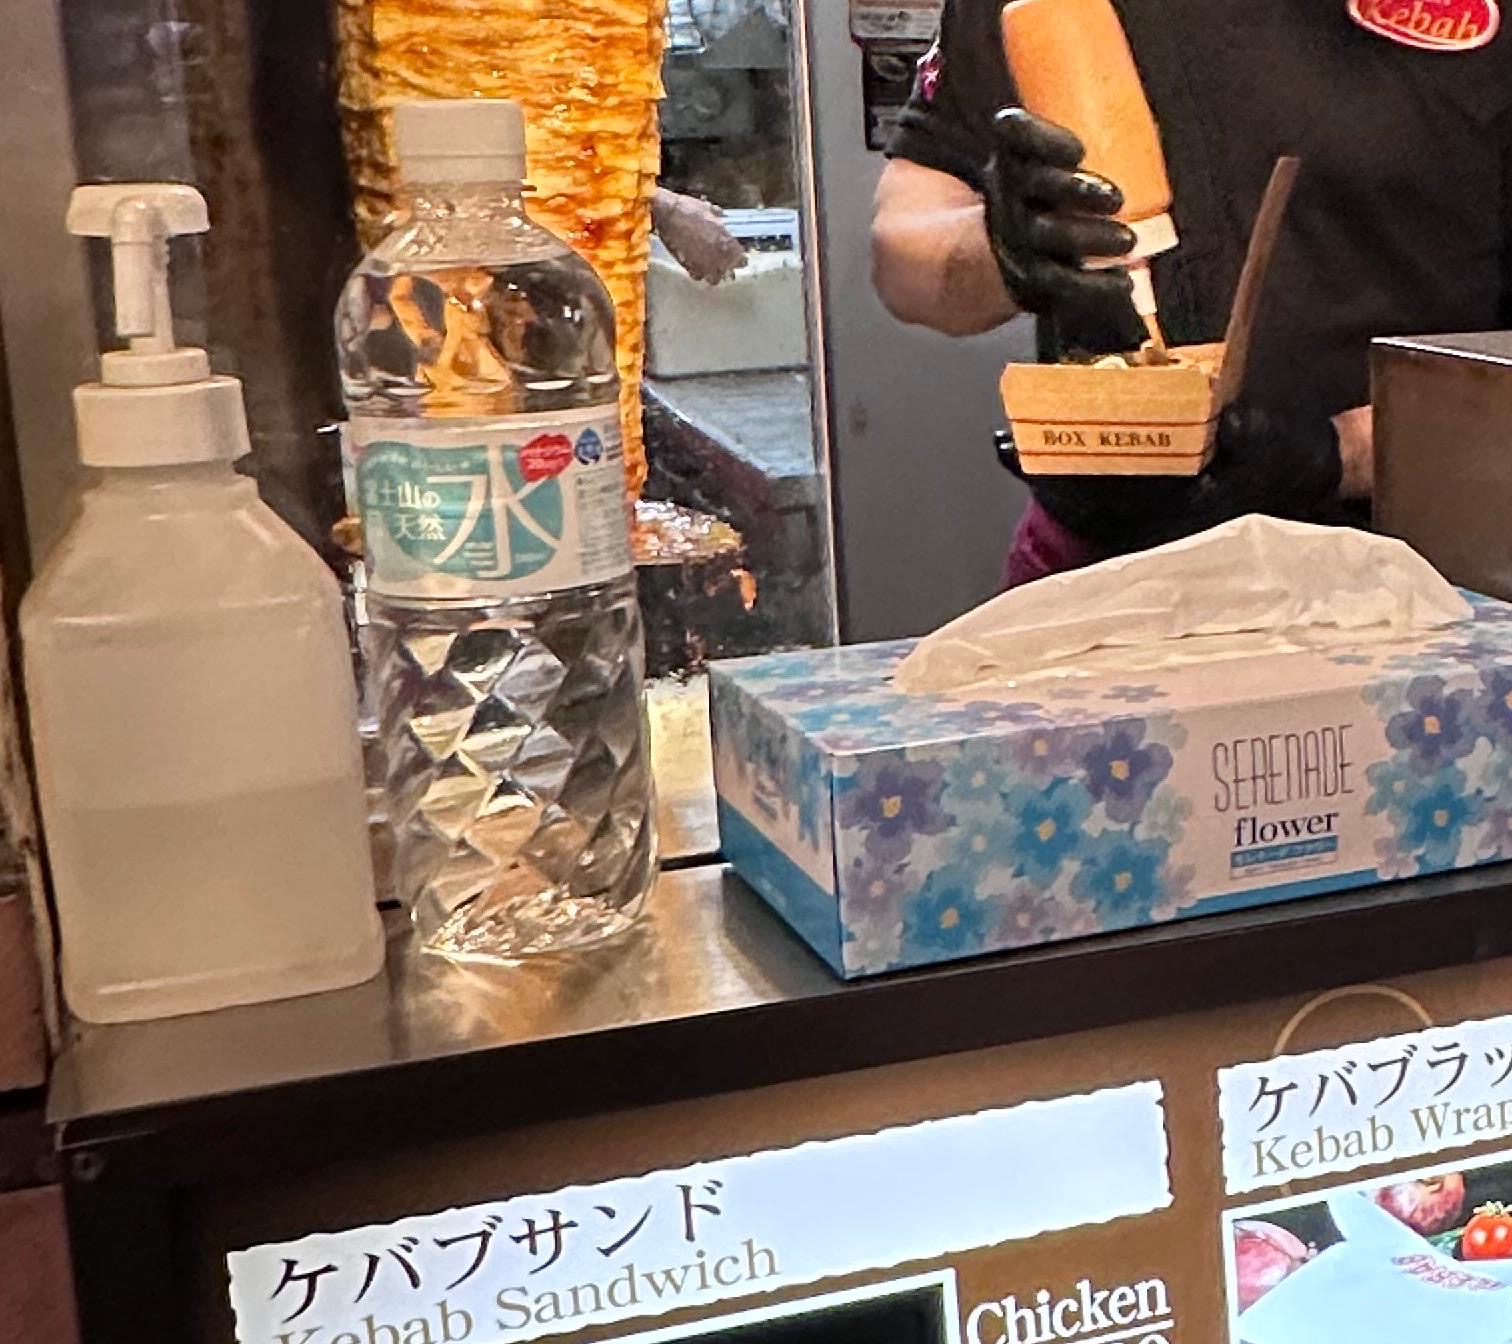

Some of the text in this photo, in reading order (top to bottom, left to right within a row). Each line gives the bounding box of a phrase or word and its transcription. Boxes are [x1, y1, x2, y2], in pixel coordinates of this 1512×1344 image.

[1042, 430, 1171, 448] BOX KEBAB
[1213, 724, 1354, 812] SERENADE
[1235, 812, 1339, 847] flower
[1250, 1126, 1396, 1178] Kebab
[272, 1179, 725, 1323] ケバブサンド
[494, 1241, 781, 1333] Sandwich
